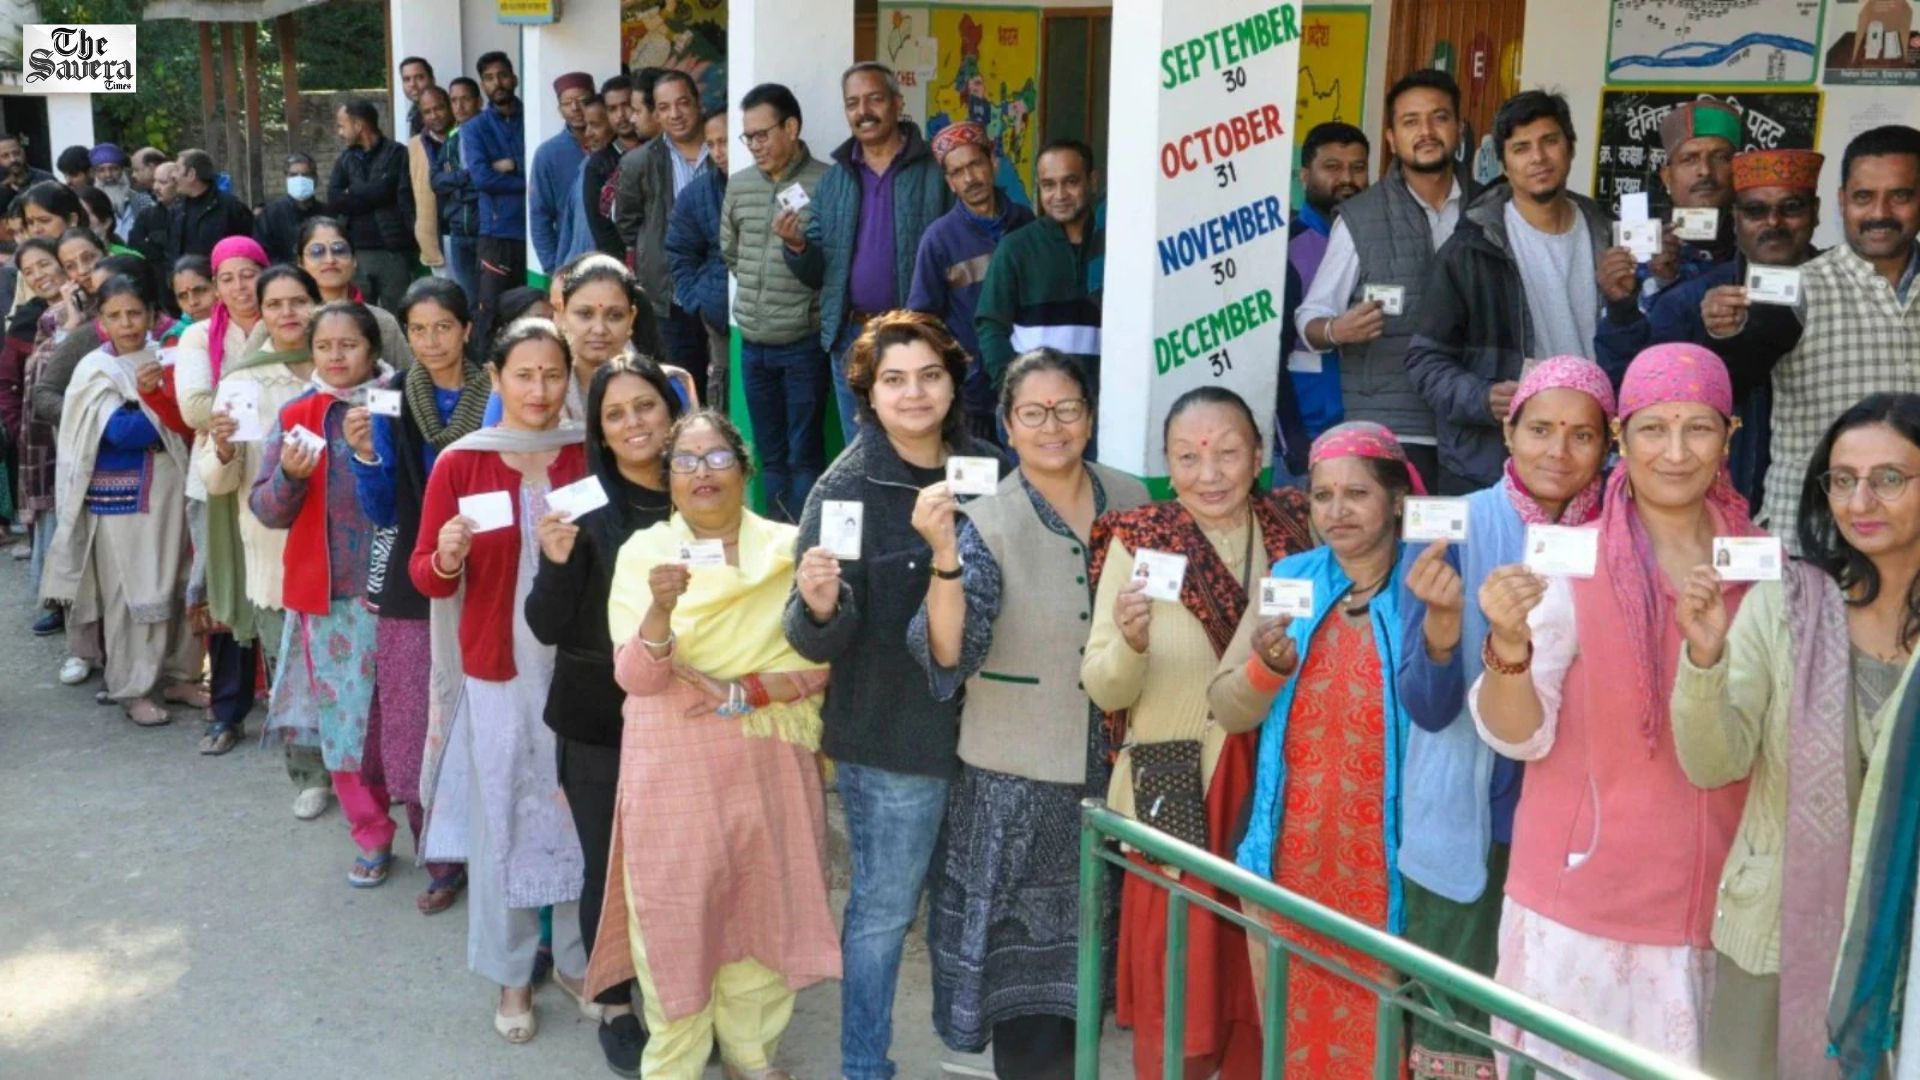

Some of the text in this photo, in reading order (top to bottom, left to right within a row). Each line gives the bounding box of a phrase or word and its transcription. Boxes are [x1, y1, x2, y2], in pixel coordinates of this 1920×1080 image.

[1160, 2, 1301, 90] SEPTEMBER
[1473, 51, 1485, 78] E
[1222, 65, 1248, 93] 30
[1160, 103, 1284, 179] OCTOBER
[1214, 161, 1237, 188] 31
[1157, 194, 1286, 277] NOVEMBER
[1210, 258, 1237, 286] 30
[1153, 288, 1278, 377] DECEMBER
[1208, 350, 1232, 377] 31
